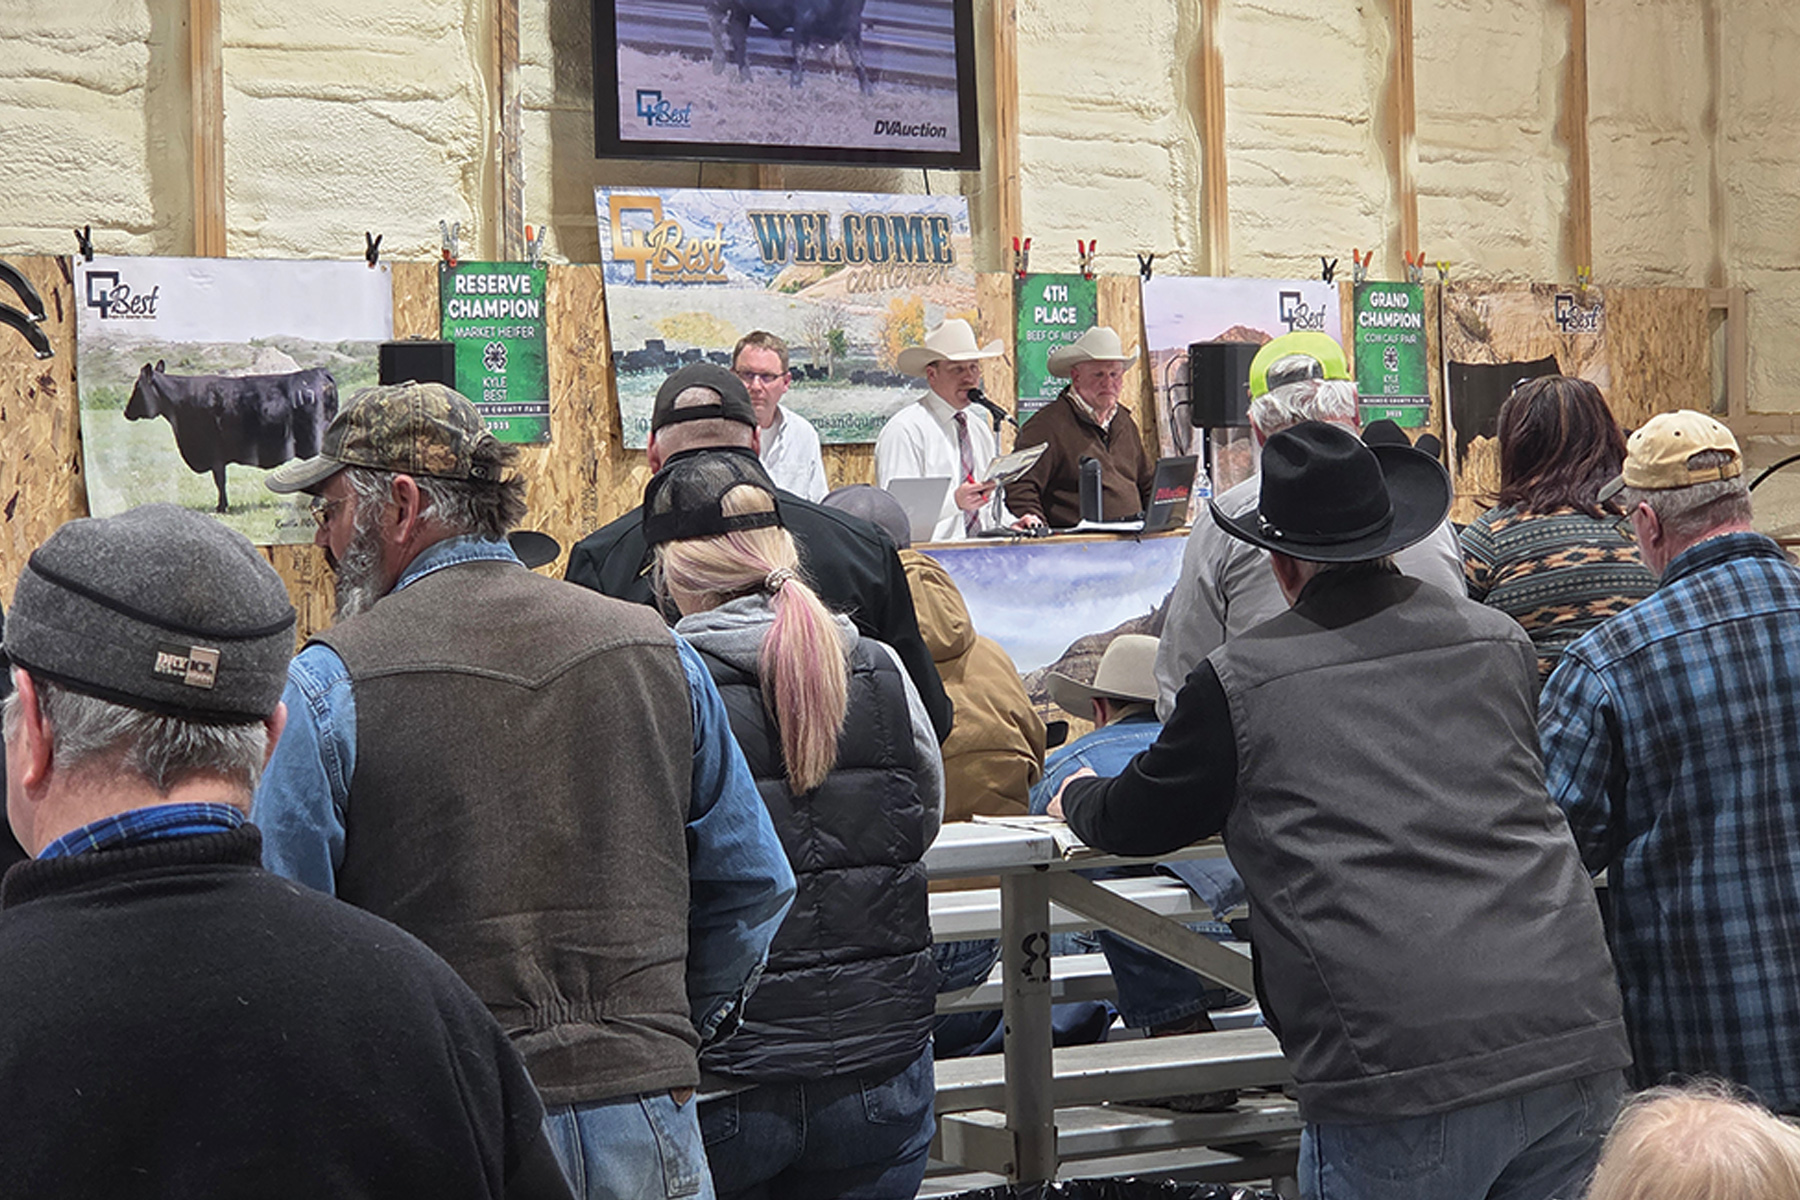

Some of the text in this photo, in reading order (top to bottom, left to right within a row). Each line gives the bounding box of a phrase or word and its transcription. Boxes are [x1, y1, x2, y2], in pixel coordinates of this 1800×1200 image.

[873, 120, 947, 138] DVAuction
[647, 219, 728, 275] Best
[747, 211, 955, 266] WELCOME
[455, 274, 532, 295] RESERVE
[1043, 285, 1068, 302] 4TH
[109, 284, 159, 315] Best
[448, 298, 540, 319] CHAMPION
[1369, 291, 1410, 309] GRAND
[1034, 307, 1077, 324] PLACE
[1294, 303, 1326, 329] Best
[1358, 312, 1422, 328] CHAMPION
[454, 325, 535, 339] MARKET HEIFER
[482, 376, 507, 389] KYLE
[483, 389, 508, 402] BEST
